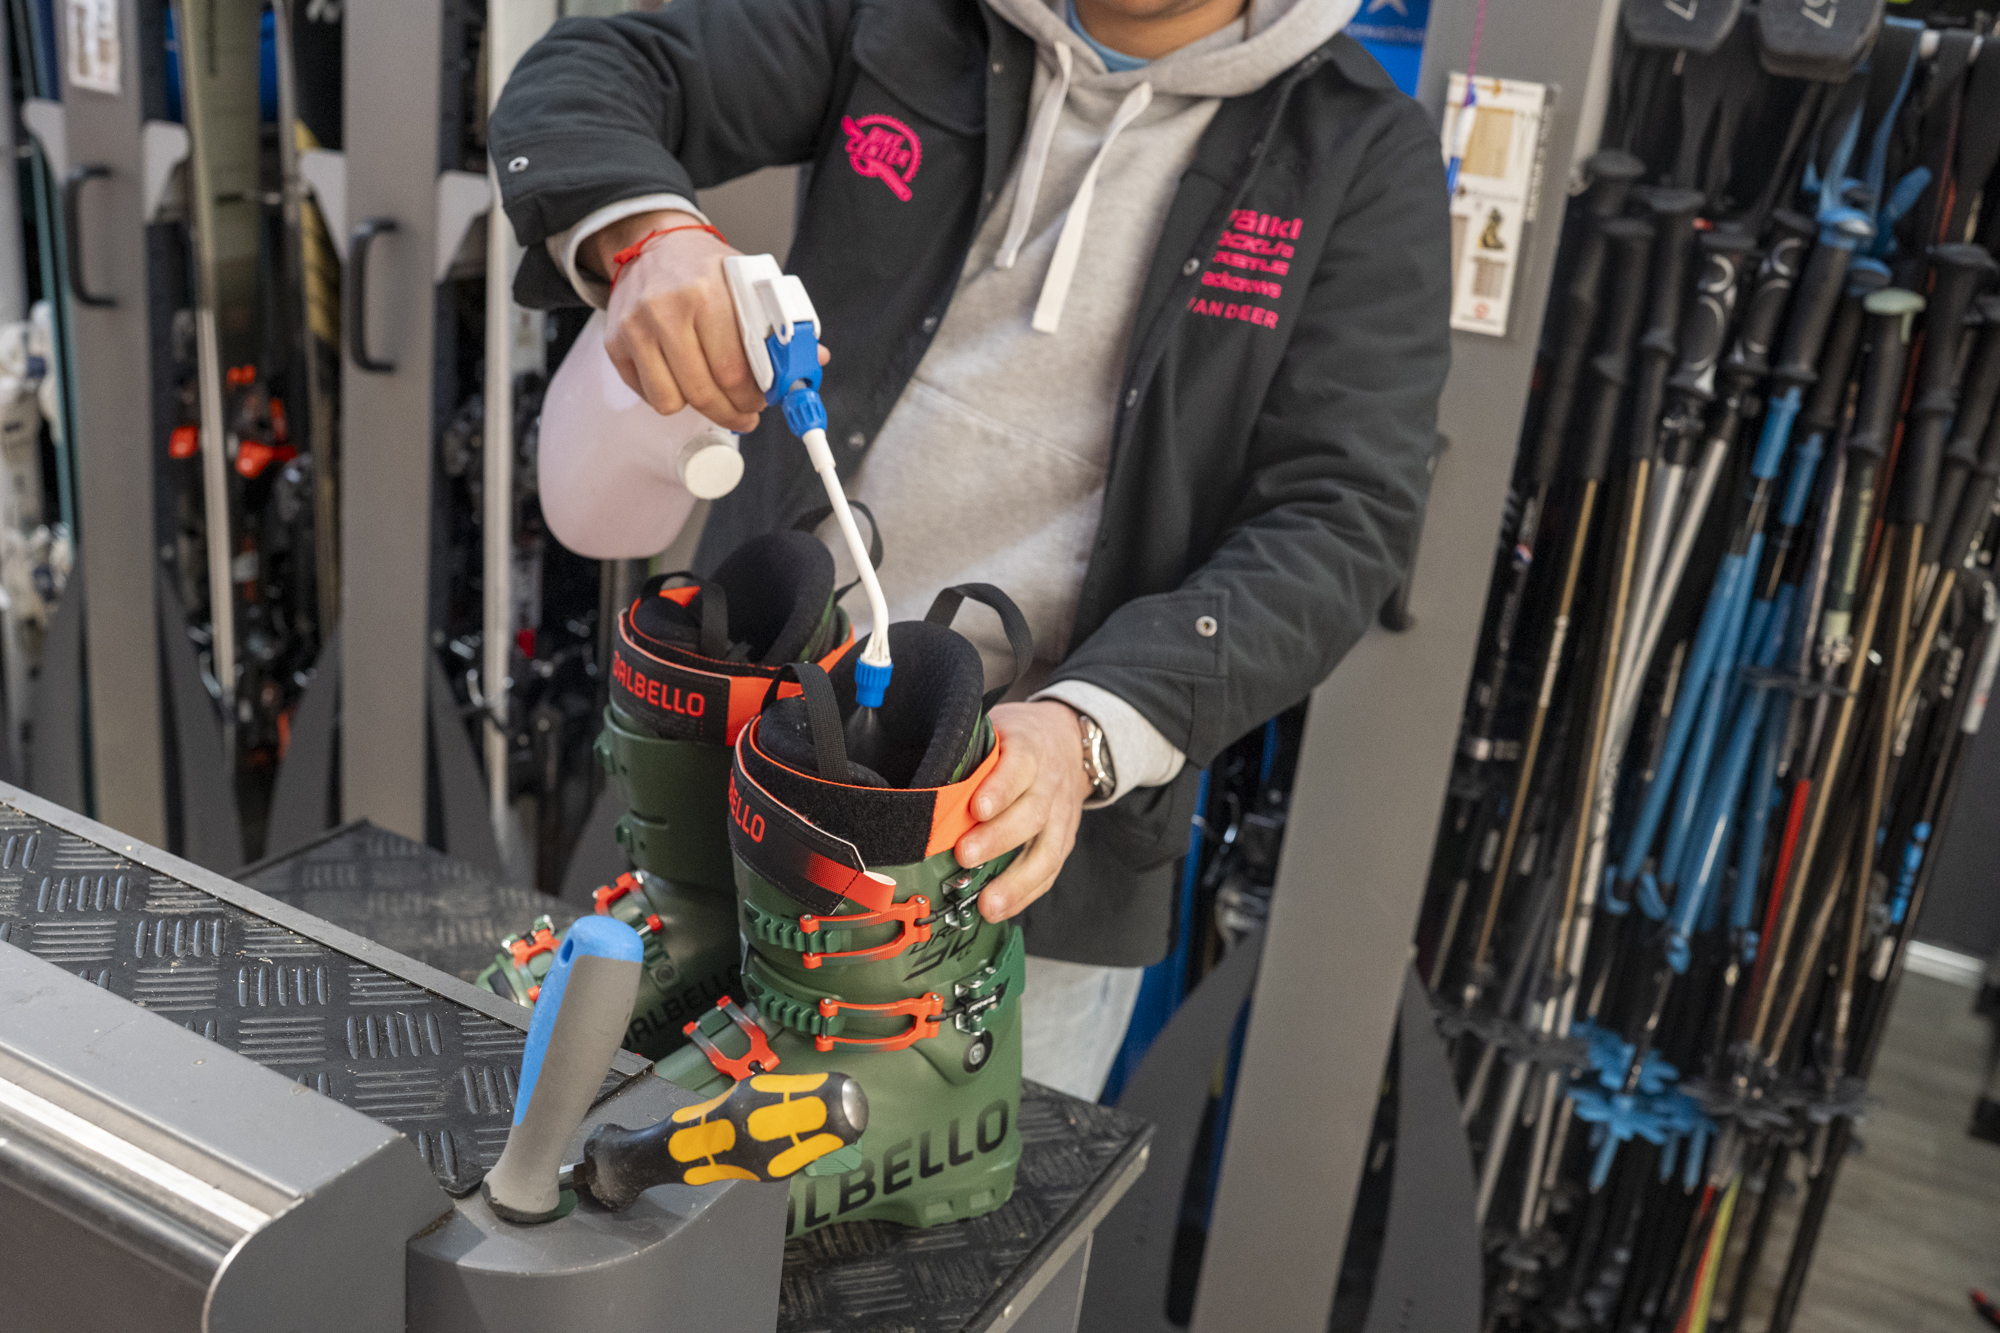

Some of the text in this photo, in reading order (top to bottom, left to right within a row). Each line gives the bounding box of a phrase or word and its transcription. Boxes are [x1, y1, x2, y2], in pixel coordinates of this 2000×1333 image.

[1224, 303, 1279, 330] DEER
[613, 650, 705, 718] DALBELLO
[785, 1098, 1009, 1238] LBELLO
